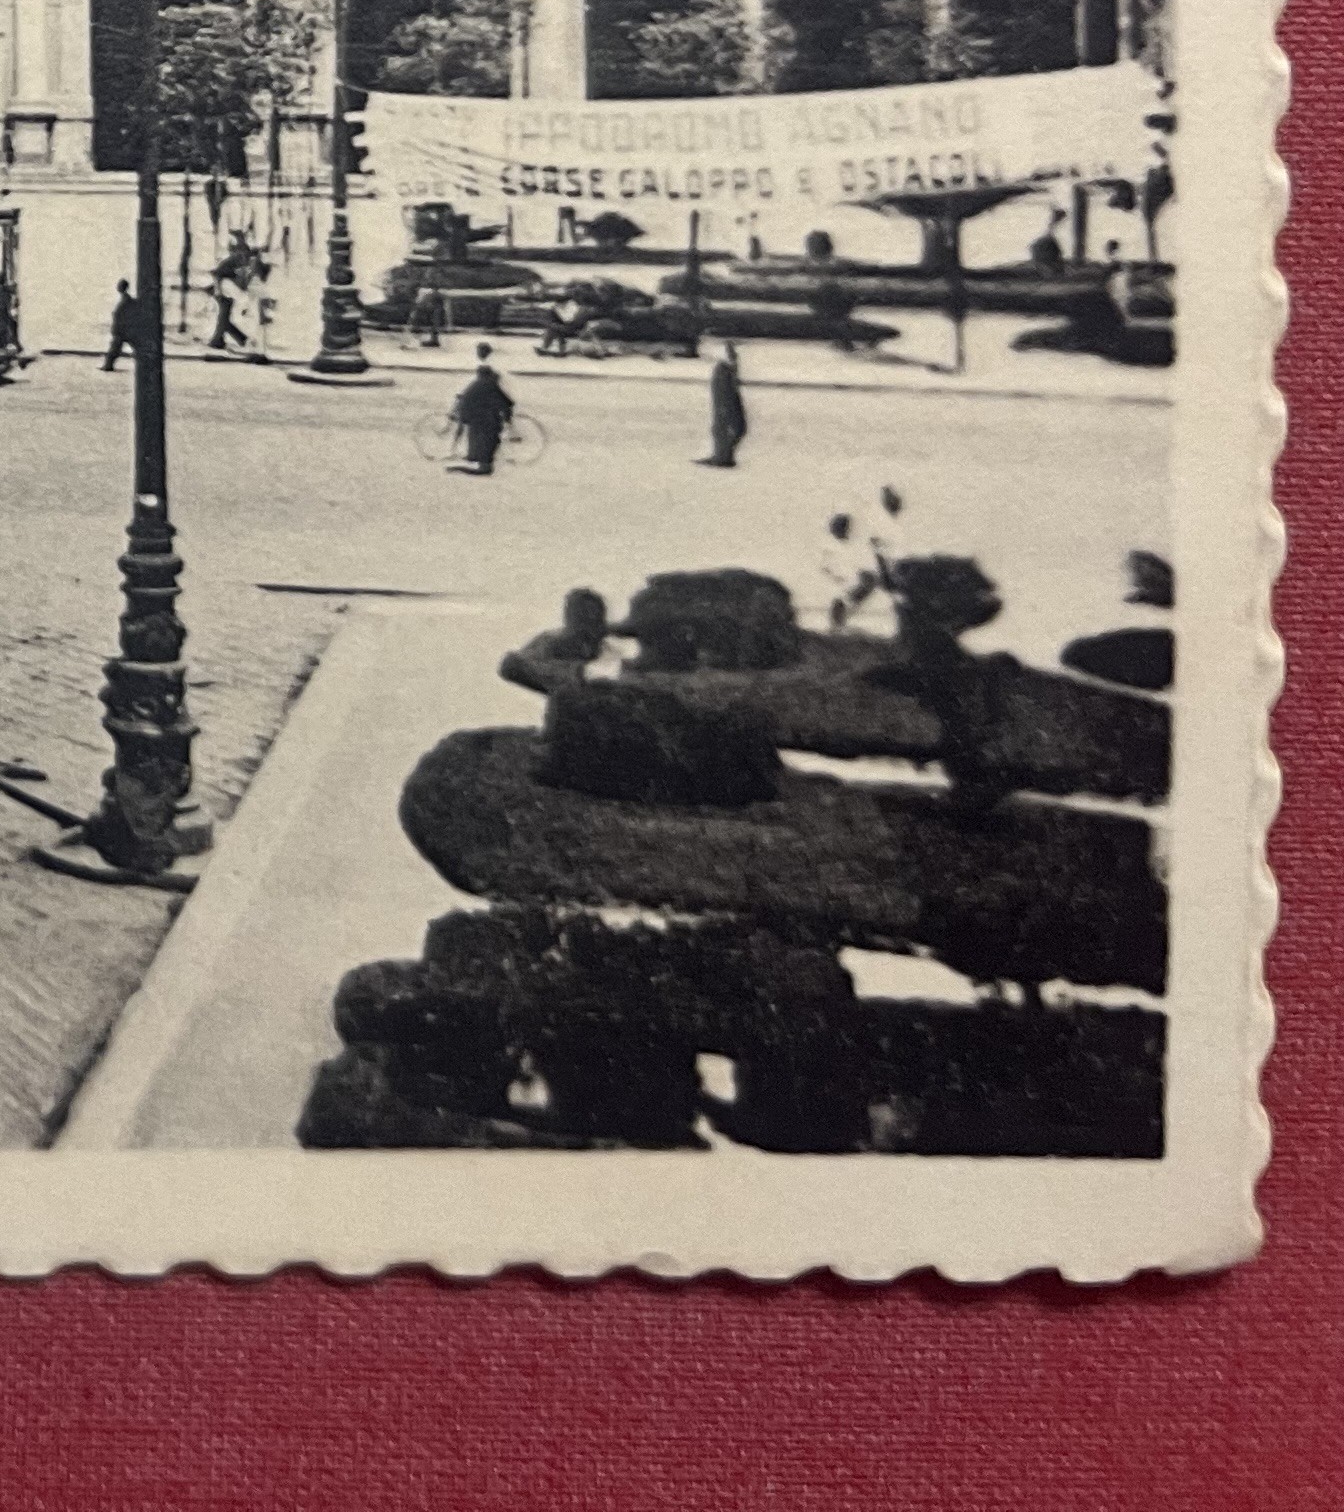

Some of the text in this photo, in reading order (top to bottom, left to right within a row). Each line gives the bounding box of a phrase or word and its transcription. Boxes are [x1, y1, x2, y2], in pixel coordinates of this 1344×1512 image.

[503, 106, 765, 155] IPPODROMO
[789, 93, 982, 146] AGNANO
[617, 166, 774, 200] GALOPPO
